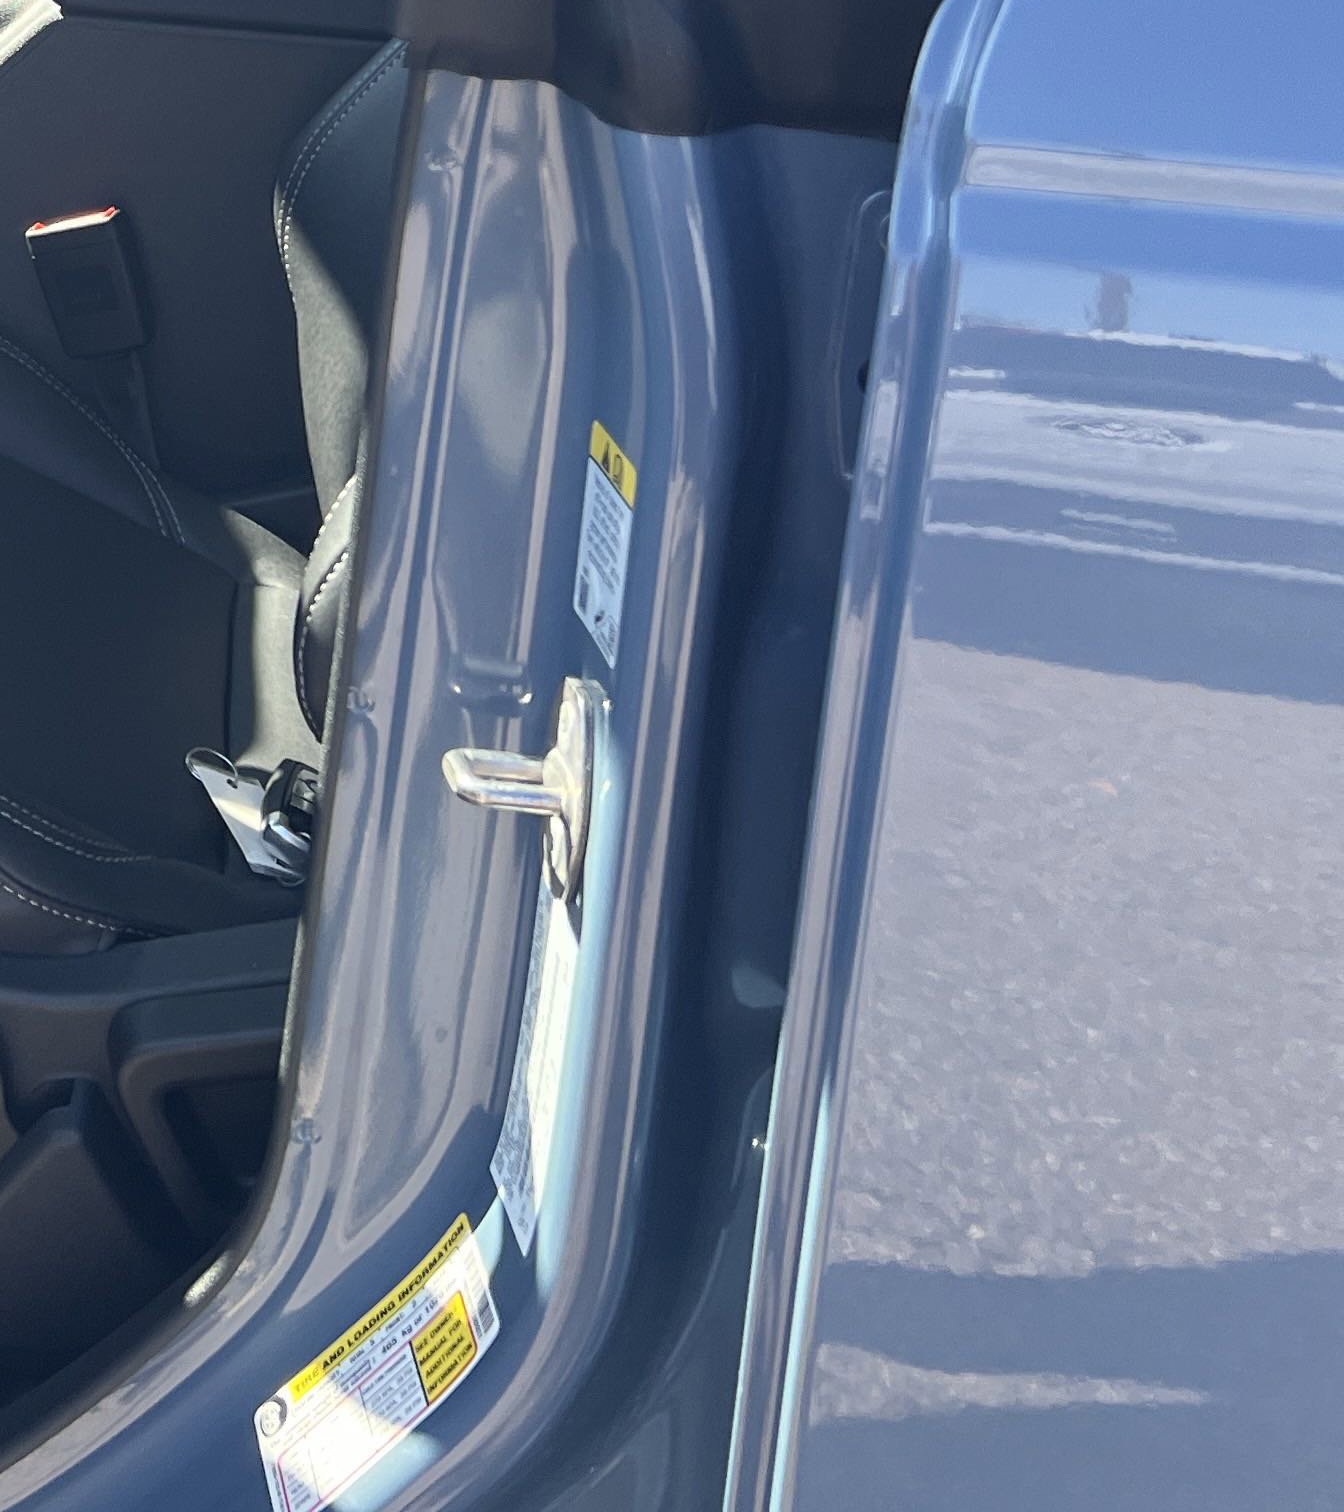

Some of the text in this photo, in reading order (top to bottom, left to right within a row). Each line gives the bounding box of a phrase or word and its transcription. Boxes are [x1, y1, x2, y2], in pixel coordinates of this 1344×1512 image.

[321, 1346, 346, 1369] AND
[347, 1301, 396, 1348] LOADING
[397, 1223, 466, 1302] INFORMATION
